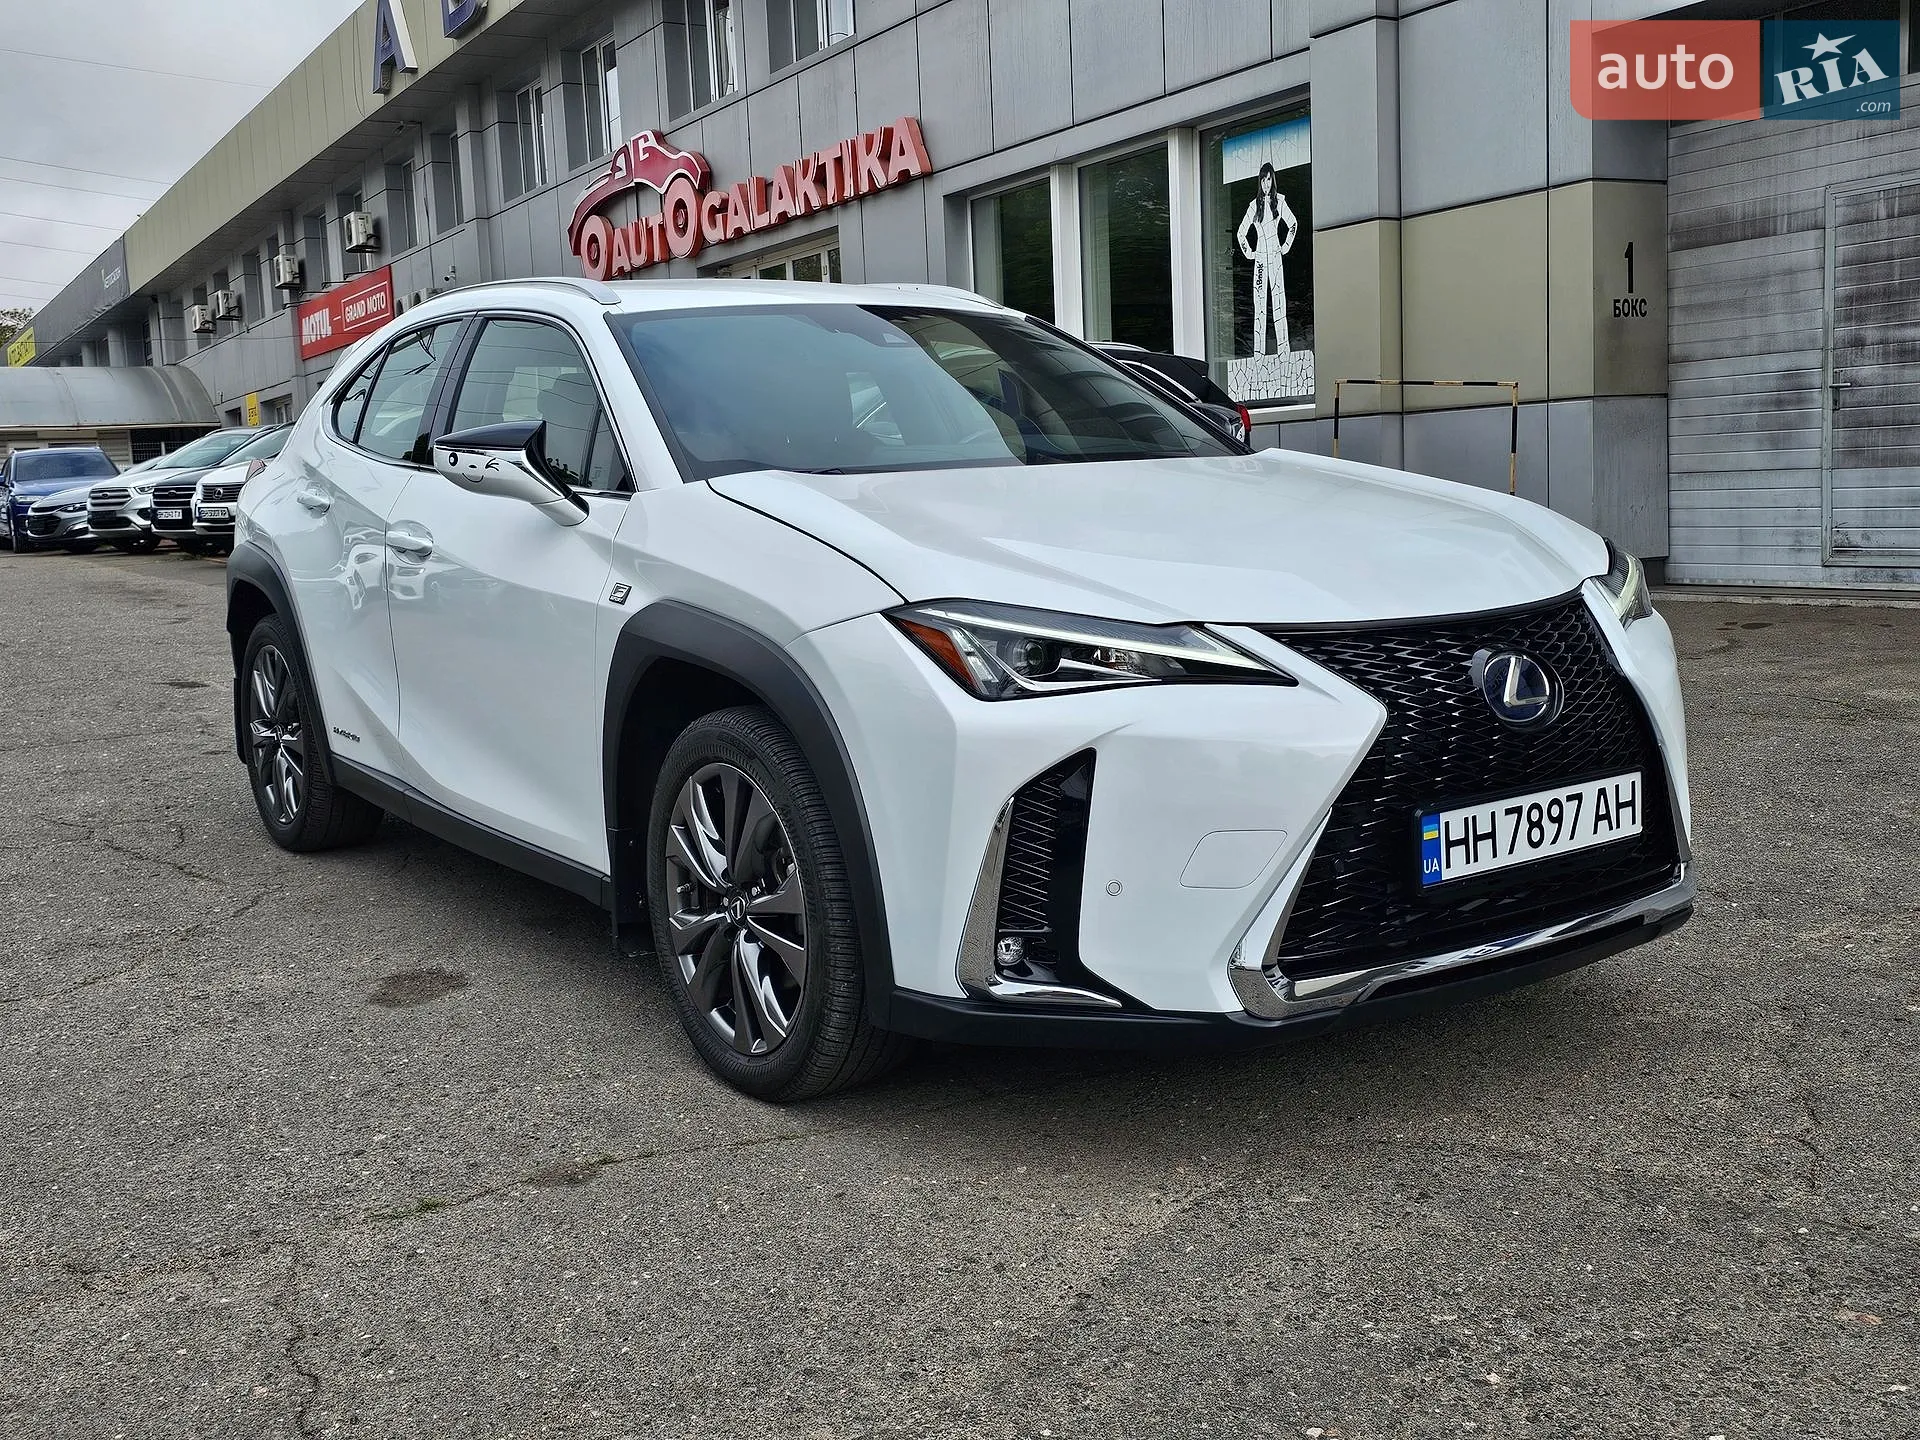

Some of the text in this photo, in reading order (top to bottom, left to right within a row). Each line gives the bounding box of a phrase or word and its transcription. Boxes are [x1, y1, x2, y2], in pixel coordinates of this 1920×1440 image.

[1624, 241, 1634, 294] 1
[302, 291, 386, 346] MOTUL GRAND MOTO
[1613, 298, 1648, 318] БОКС
[1444, 780, 1637, 870] HH 7897 AH
[1423, 858, 1440, 875] UA
